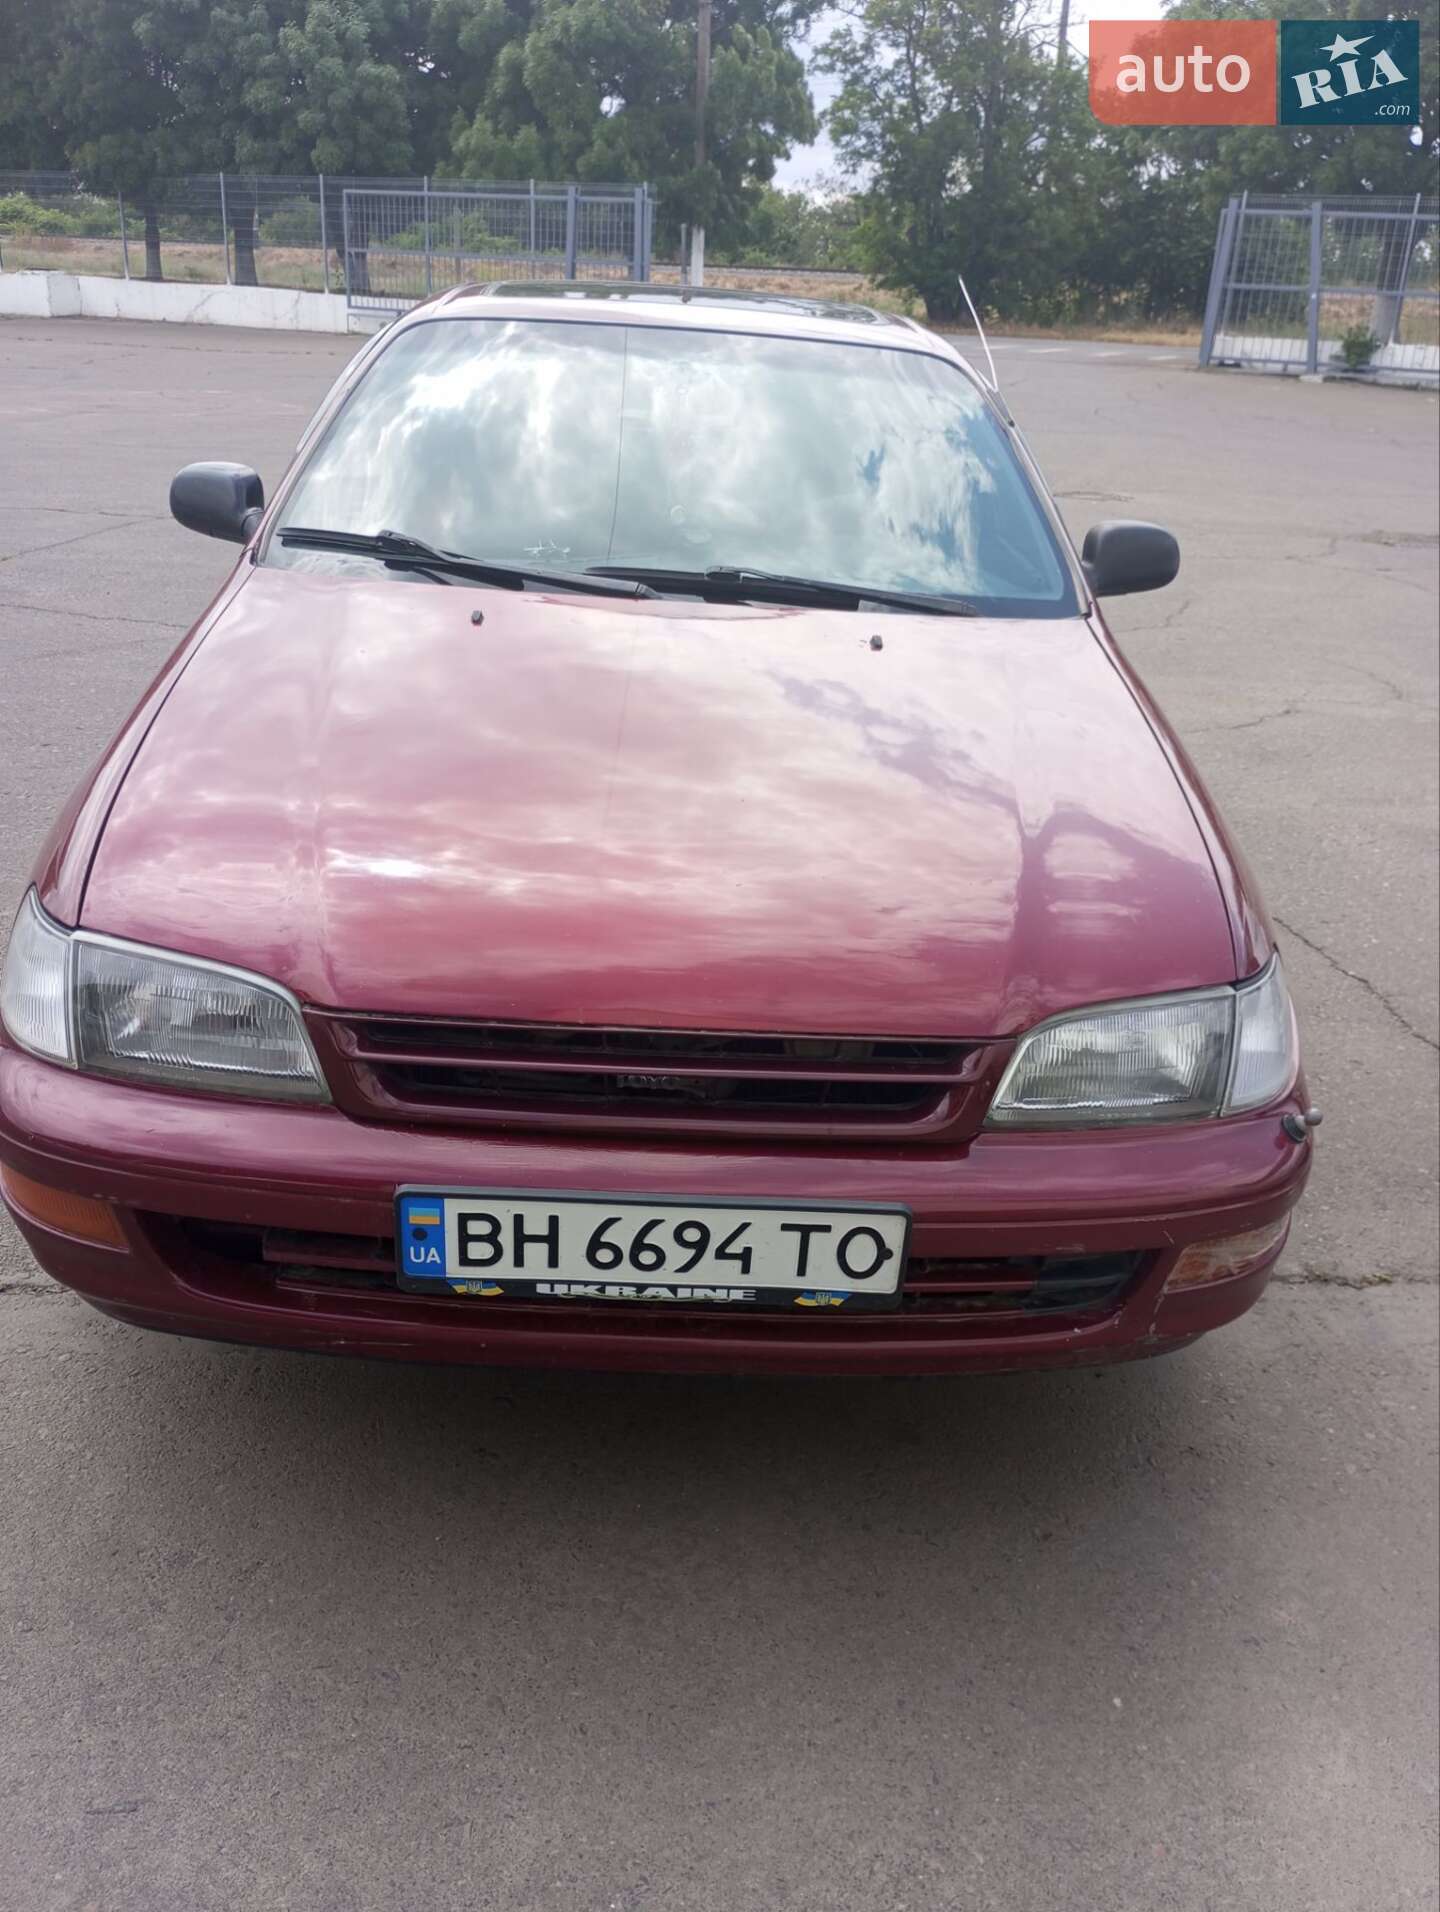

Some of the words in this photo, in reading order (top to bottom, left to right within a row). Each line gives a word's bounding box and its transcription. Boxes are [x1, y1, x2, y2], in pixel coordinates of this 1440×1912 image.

[410, 1246, 441, 1264] UA
[457, 1212, 559, 1269] BH
[585, 1216, 752, 1274] 6694
[780, 1223, 890, 1279] TO
[536, 1283, 757, 1302] UKRAINE
